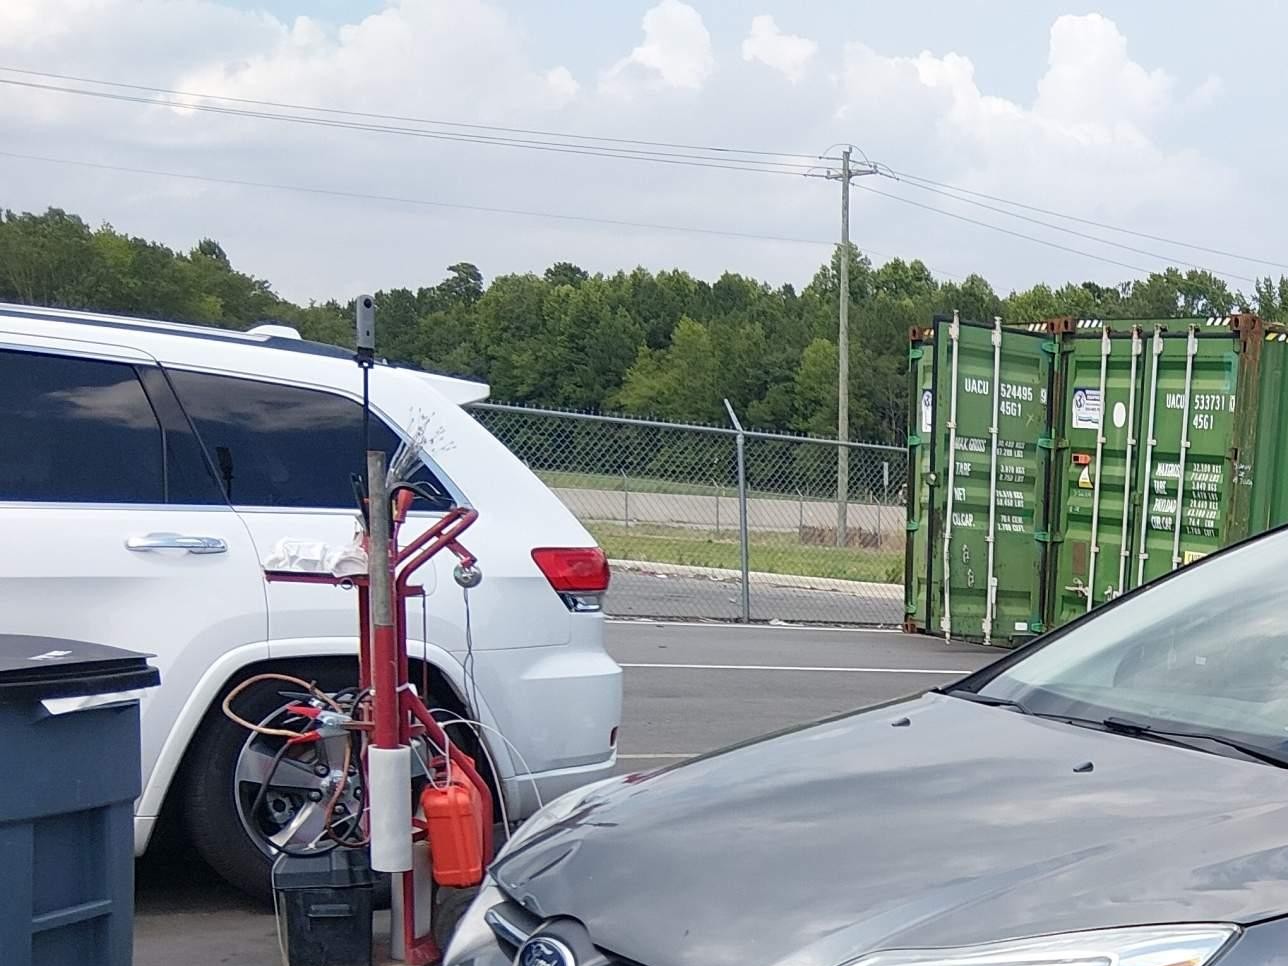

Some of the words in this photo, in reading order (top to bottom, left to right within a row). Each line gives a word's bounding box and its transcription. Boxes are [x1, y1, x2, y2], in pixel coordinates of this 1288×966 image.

[964, 377, 989, 395] UACU
[1000, 383, 1033, 401] 524495
[1000, 400, 1022, 417] 45G1
[1166, 393, 1185, 409] UACU
[1194, 394, 1225, 411] 533731
[1193, 414, 1214, 430] 45G1
